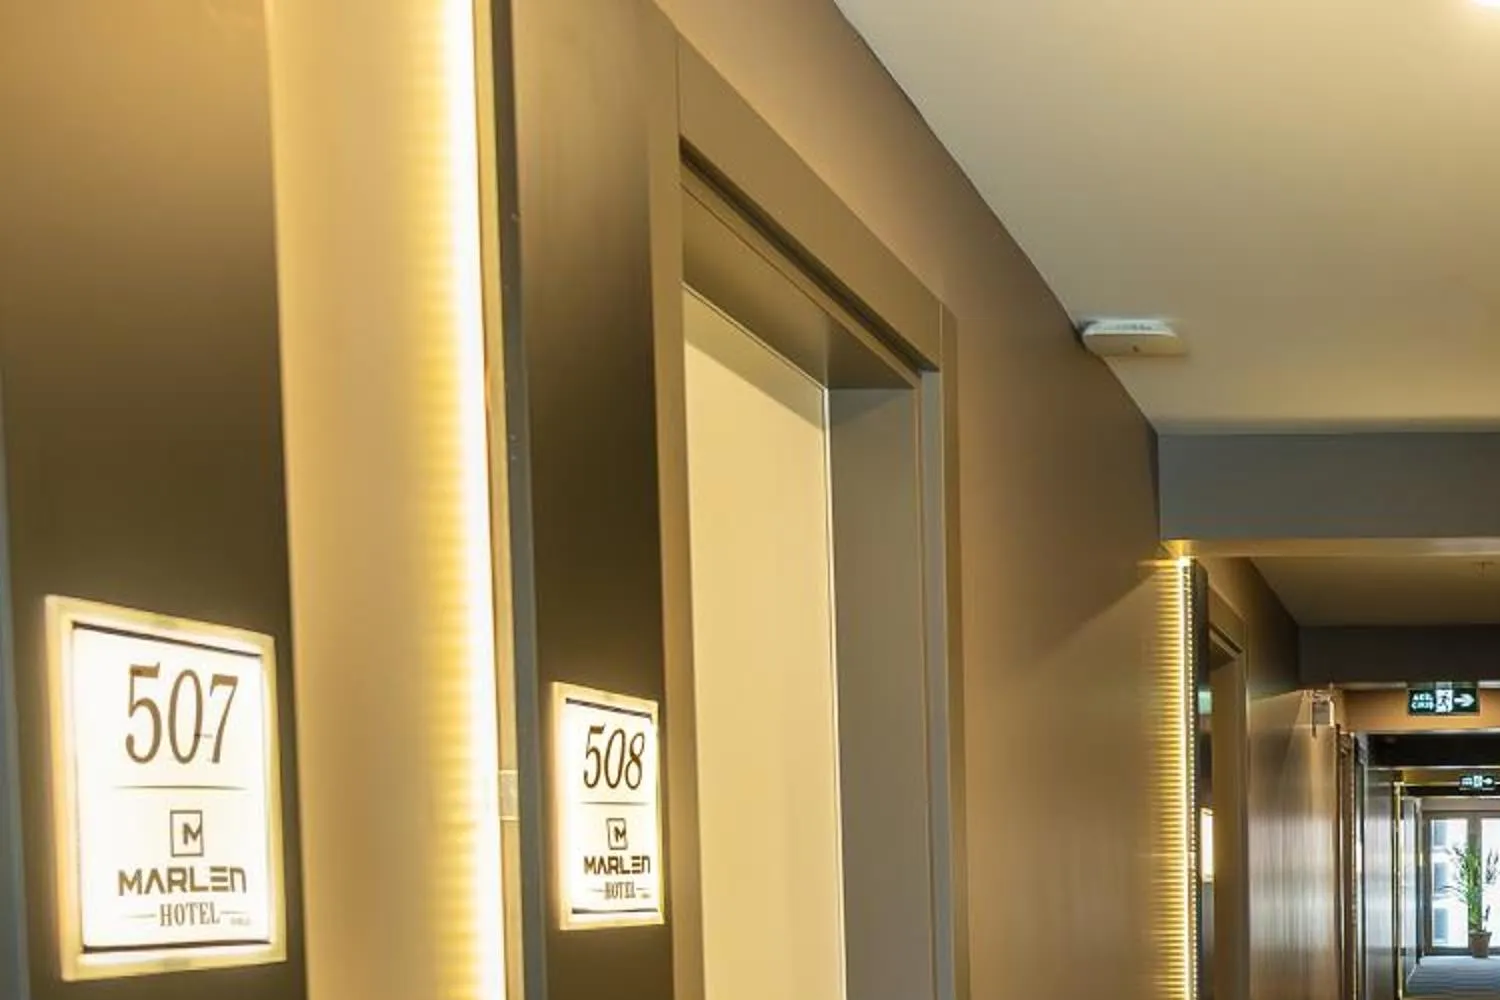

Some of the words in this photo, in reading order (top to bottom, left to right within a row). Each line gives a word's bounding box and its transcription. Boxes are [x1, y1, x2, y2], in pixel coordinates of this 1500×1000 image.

[125, 661, 239, 765] 507
[583, 723, 645, 790] 508
[584, 856, 651, 874] MARLEN
[118, 866, 247, 896] MARLEN
[160, 902, 220, 927] HOTEL
